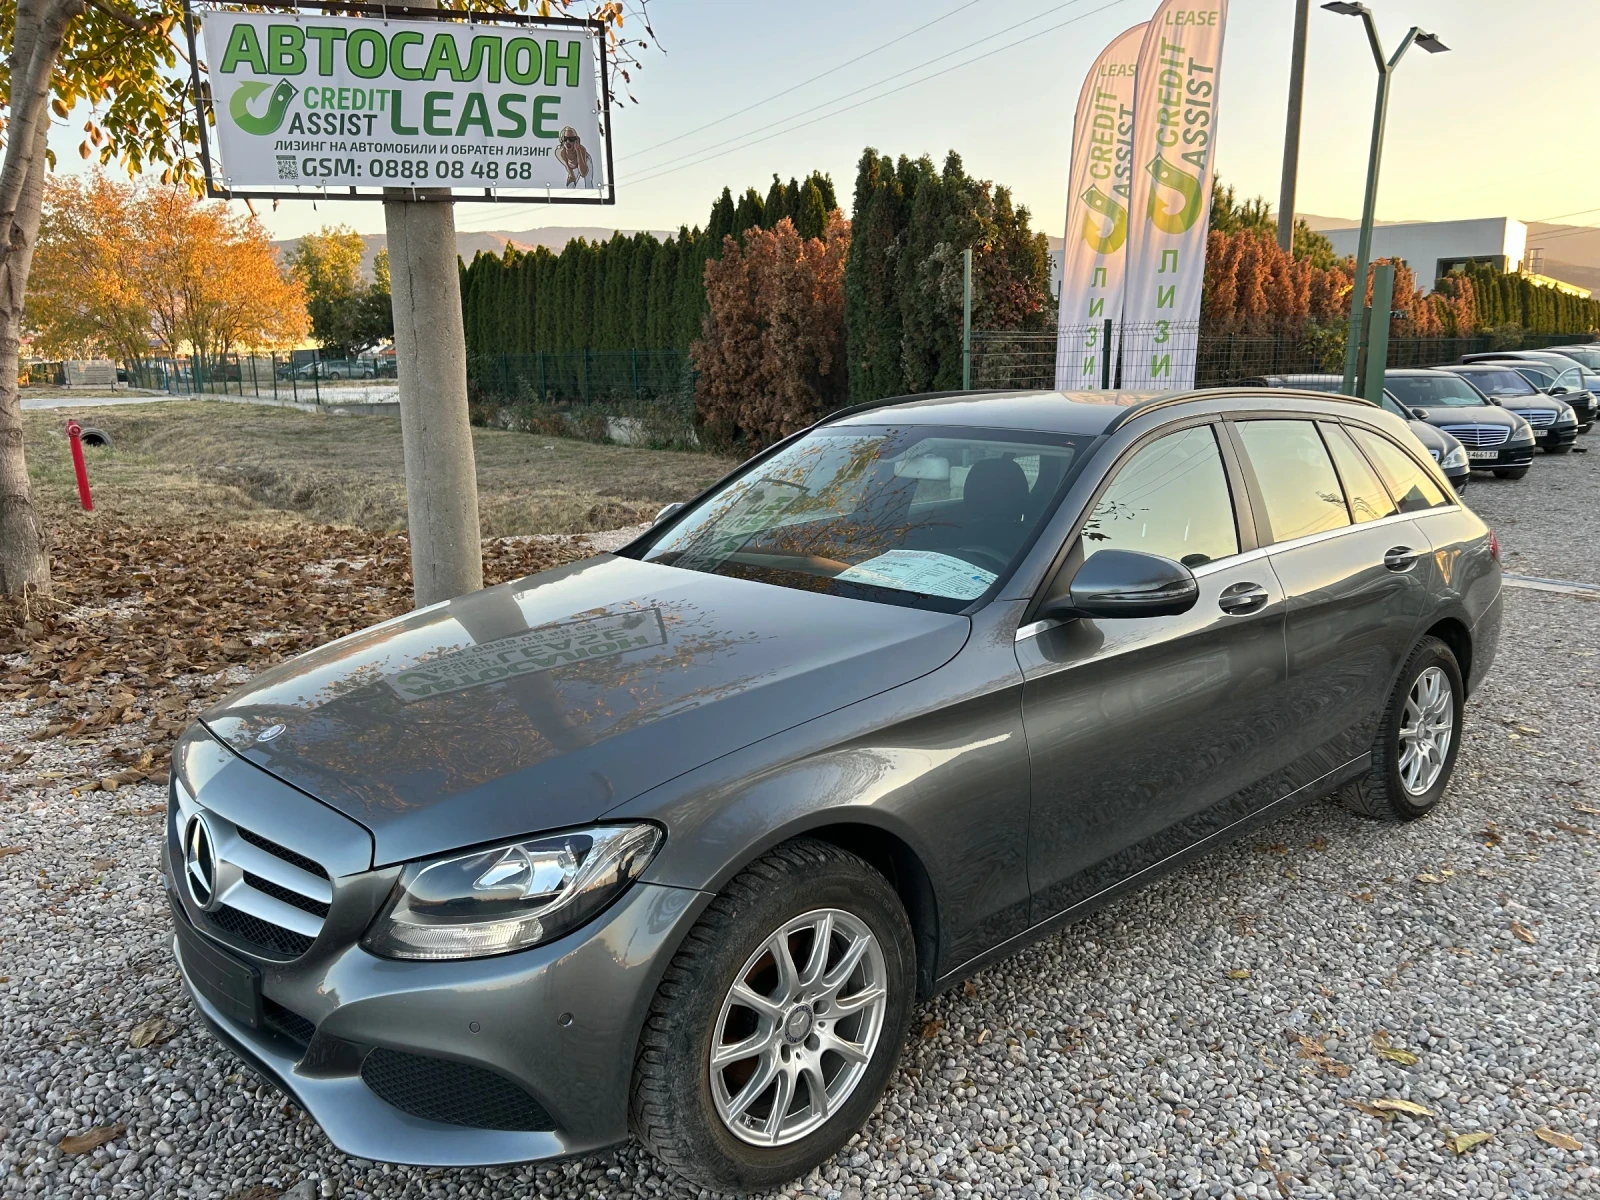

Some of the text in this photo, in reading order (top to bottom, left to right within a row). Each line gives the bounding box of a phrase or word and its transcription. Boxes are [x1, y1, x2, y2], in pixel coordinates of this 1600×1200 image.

[1165, 10, 1218, 26] LEASE
[220, 23, 581, 88] АВТОСАЛОН
[1100, 63, 1136, 77] LEAS
[303, 86, 391, 111] CREDIT
[391, 89, 562, 139] LEASE
[1156, 36, 1185, 148] CREDIT
[1181, 57, 1213, 171] ASSIST
[274, 140, 553, 157] ЛИЗИНГ НА АВТОМОБИЛИ И ОБРАТЕН ЛИЗИНГ
[288, 112, 378, 137] ASSIST
[1090, 86, 1118, 180] CREDIT
[302, 157, 532, 181] GSM: 0888 08 48 68
[1081, 267, 1107, 390] ЛИЗИ
[1150, 249, 1178, 389] ЛИЗИ
